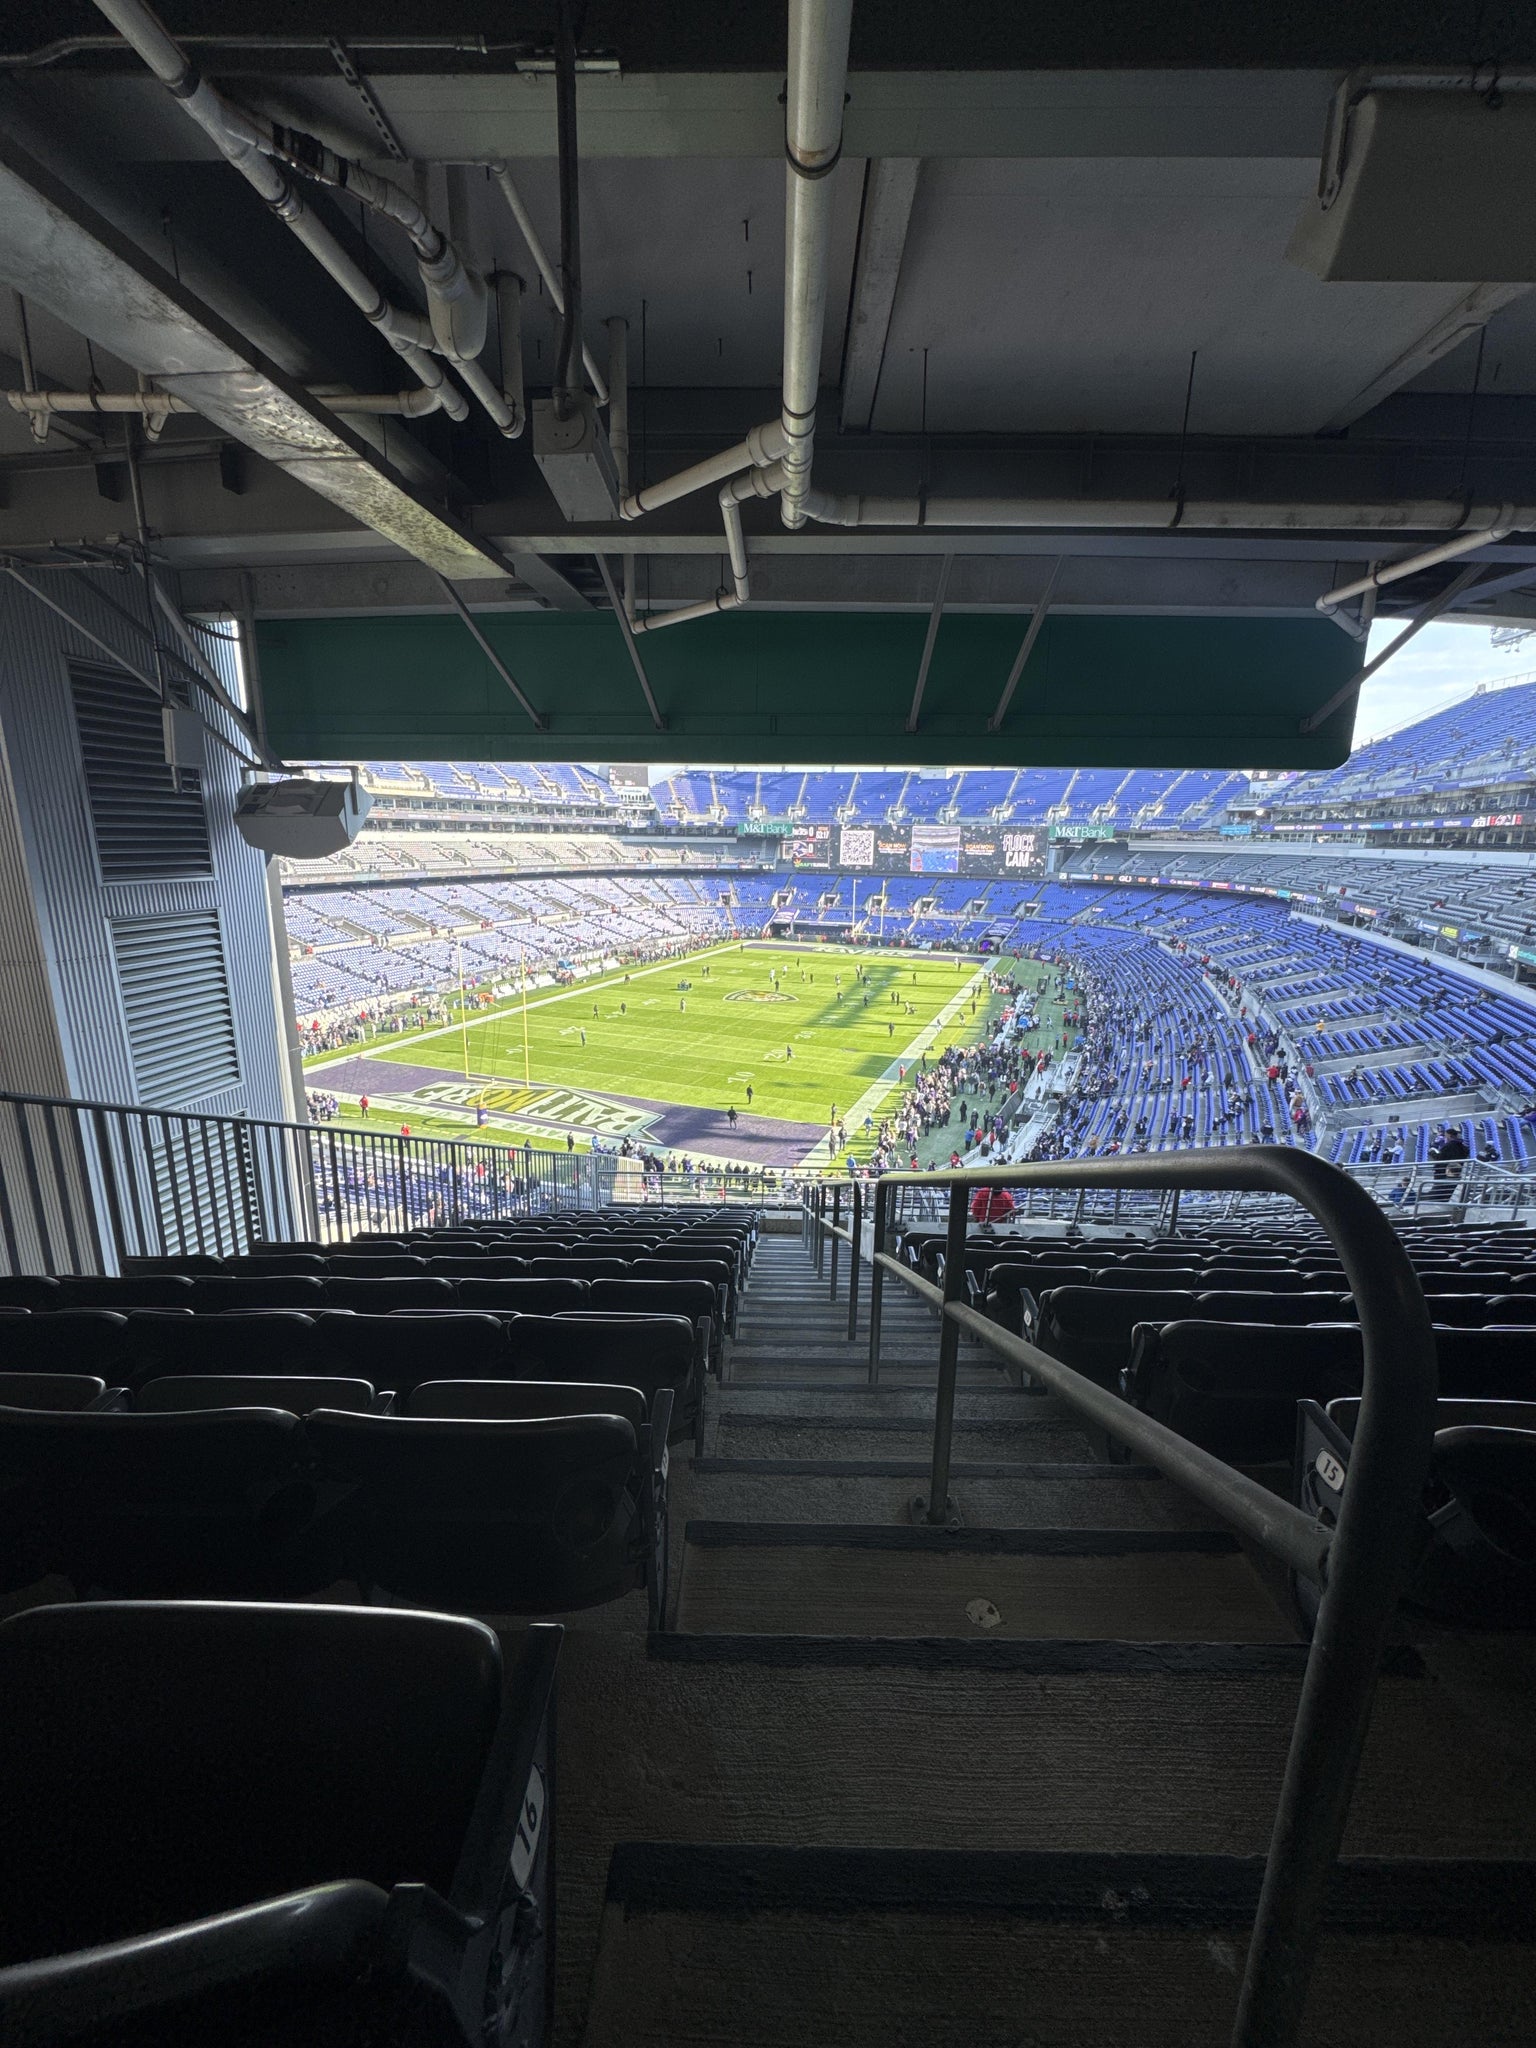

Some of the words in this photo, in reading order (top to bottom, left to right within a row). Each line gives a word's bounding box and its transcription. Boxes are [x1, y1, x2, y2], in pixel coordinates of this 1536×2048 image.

[743, 824, 767, 833] M&T
[767, 824, 788, 834] Bank
[1055, 826, 1081, 837] M&T
[1081, 826, 1107, 837] Bank
[1003, 834, 1035, 851] FLOCK
[1006, 851, 1029, 867] CAM
[1323, 1458, 1338, 1482] 15
[517, 1797, 538, 1856] 16
